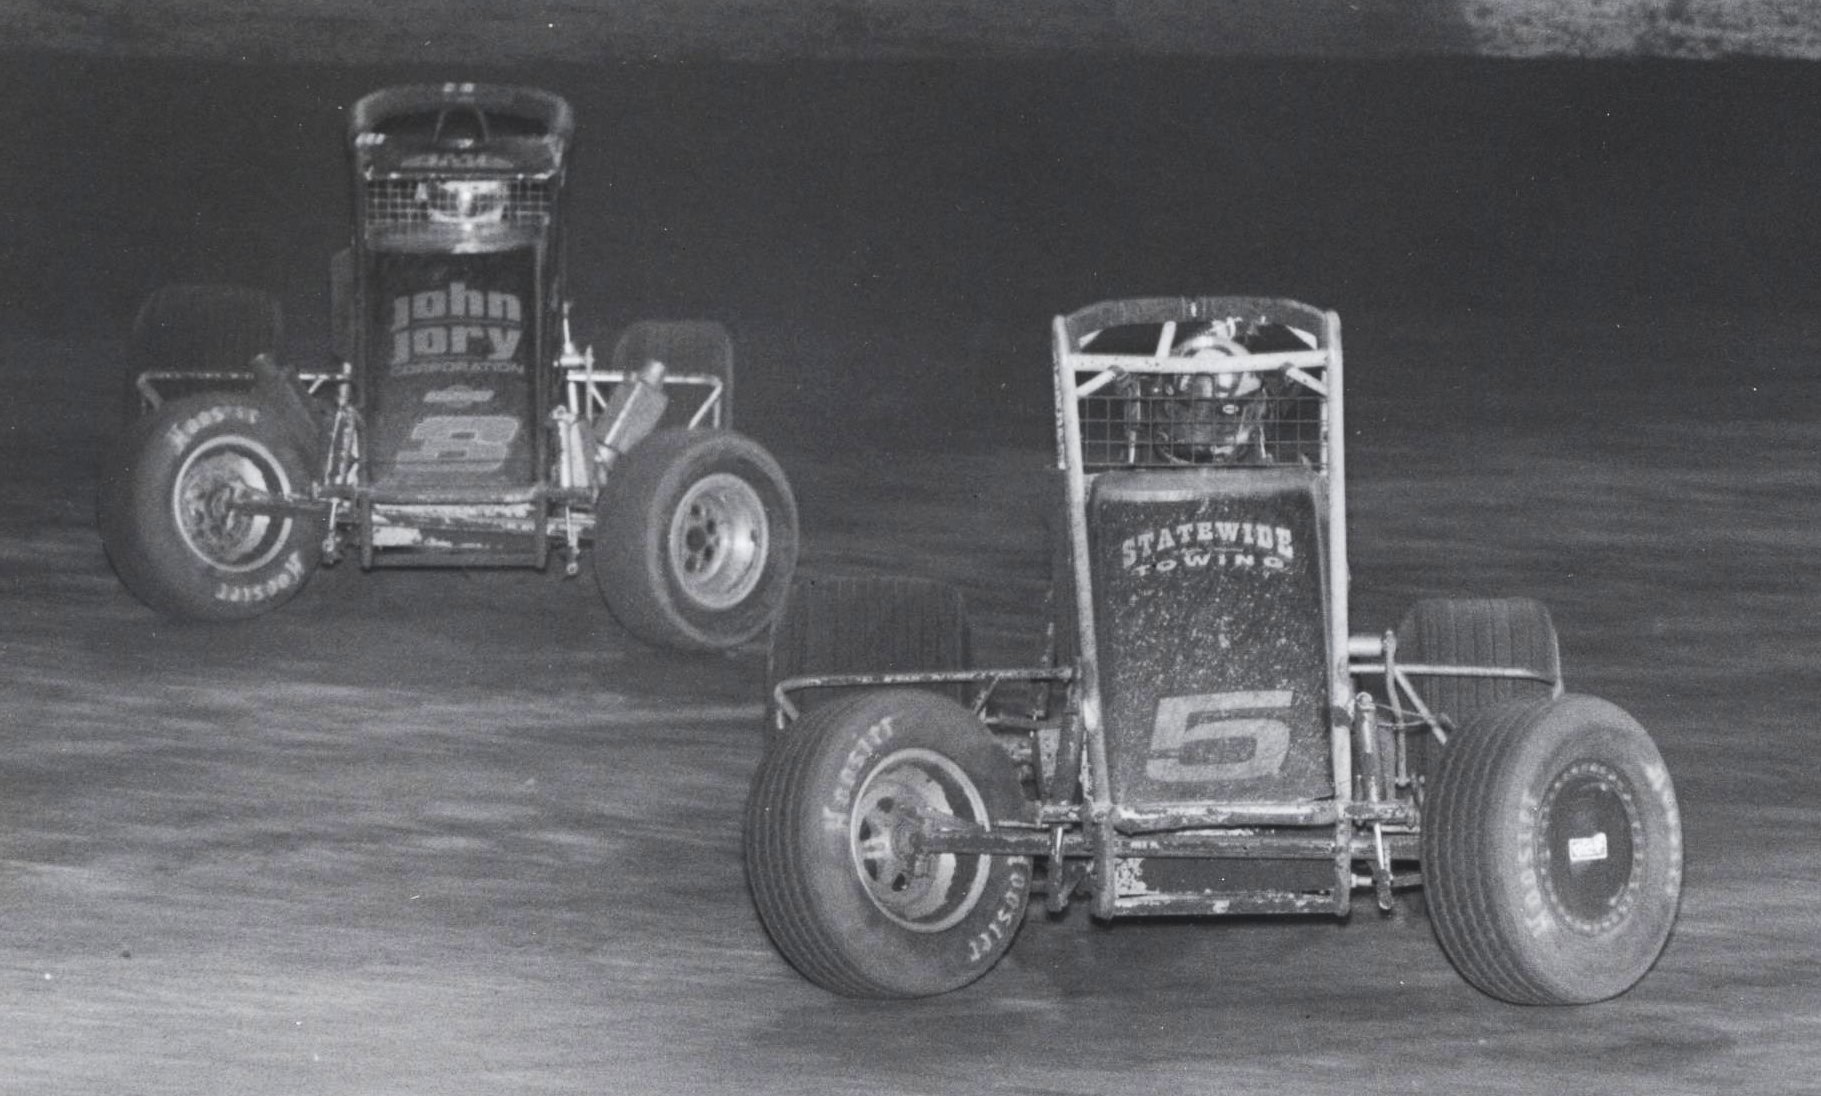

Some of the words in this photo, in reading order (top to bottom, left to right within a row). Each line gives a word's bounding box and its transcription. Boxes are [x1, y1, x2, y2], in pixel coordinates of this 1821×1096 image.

[391, 282, 521, 332] john
[391, 325, 522, 365] jory
[1122, 521, 1294, 569] STATEWIDE
[1147, 690, 1293, 781] 5
